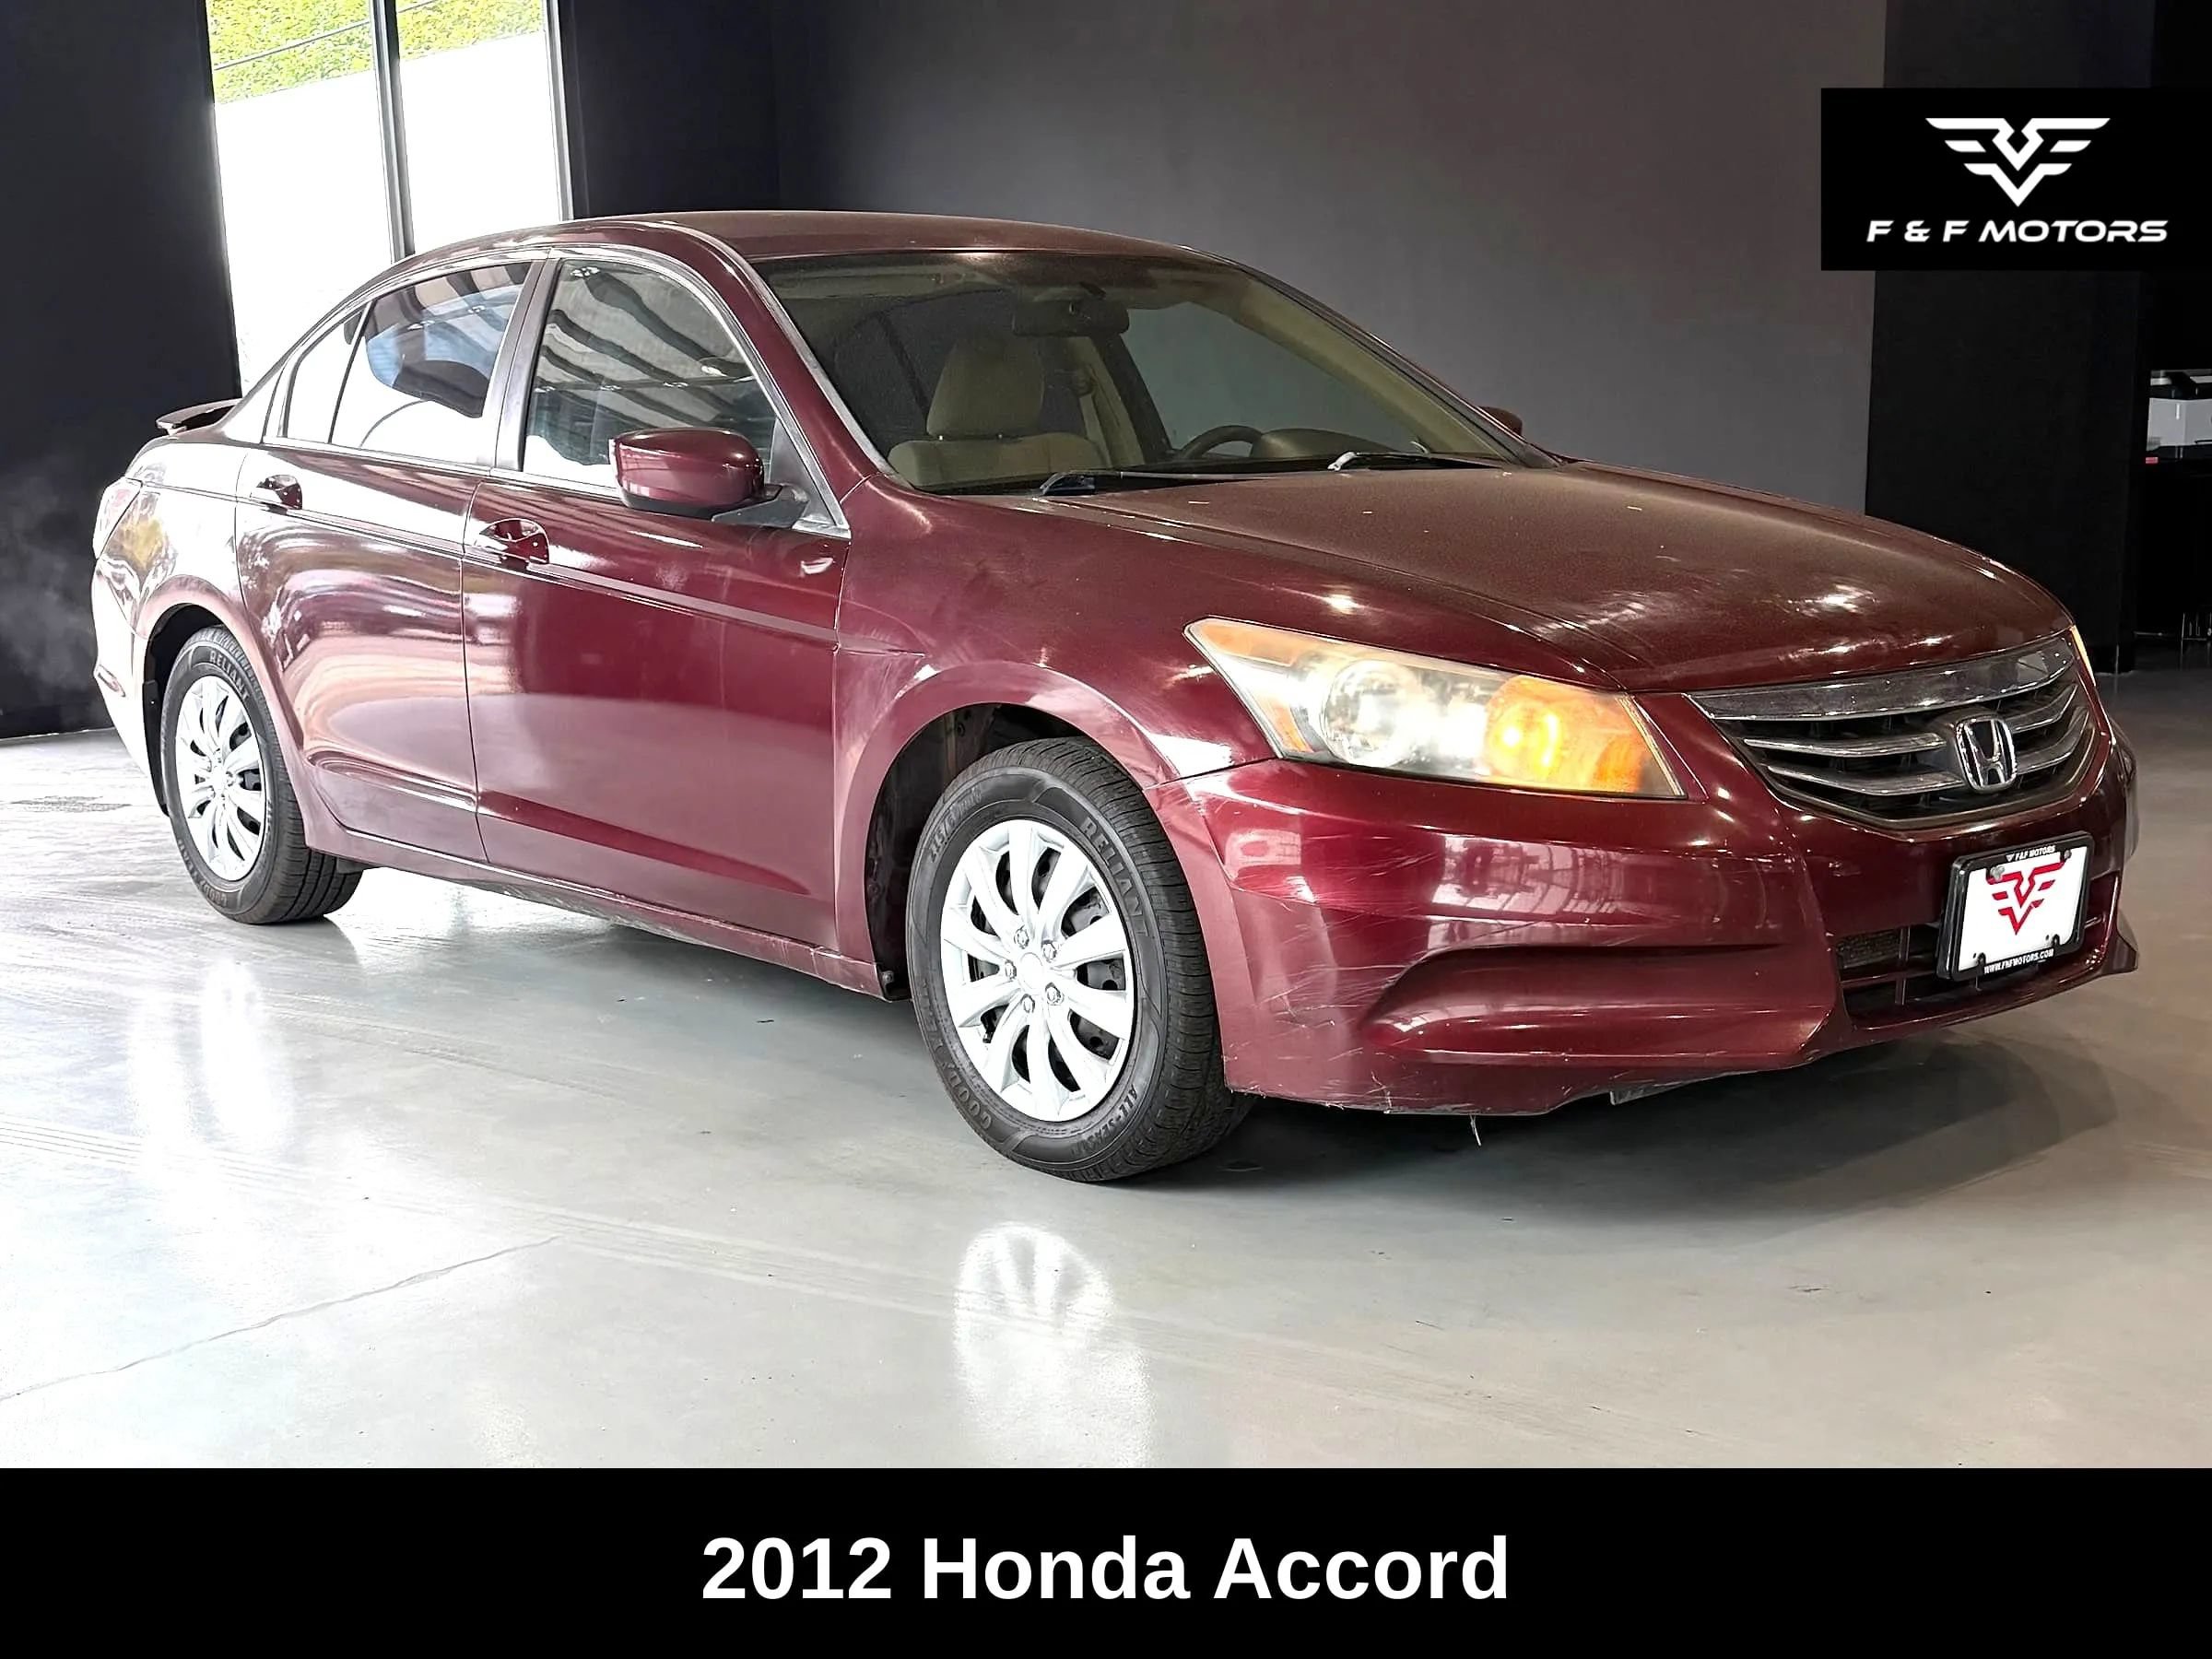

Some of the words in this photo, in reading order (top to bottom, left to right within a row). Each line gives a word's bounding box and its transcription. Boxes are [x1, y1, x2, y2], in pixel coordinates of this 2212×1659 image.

[209, 650, 250, 700] RELIANT
[2029, 845, 2056, 858] MOTORS
[1080, 817, 1150, 937] RELIANT
